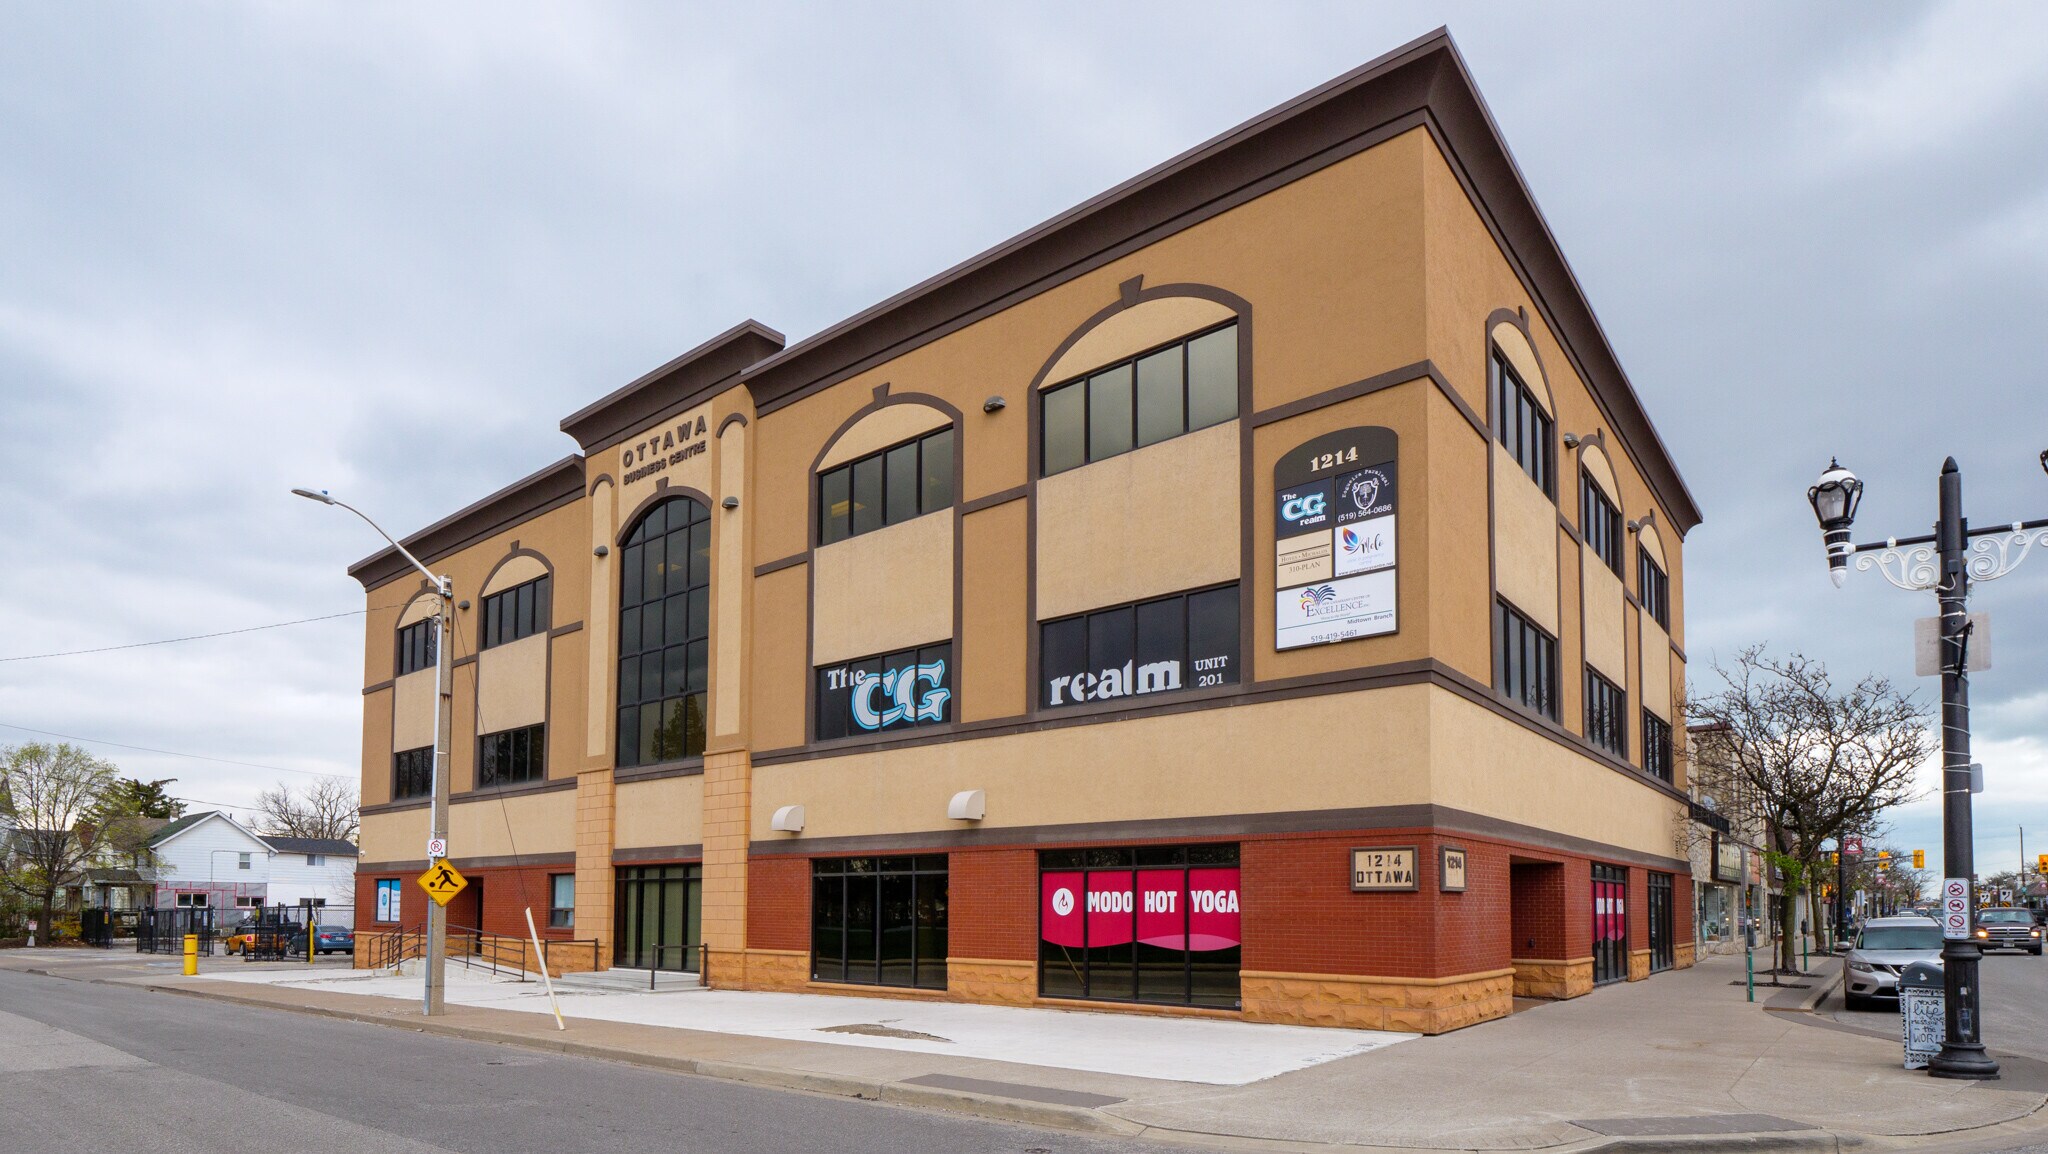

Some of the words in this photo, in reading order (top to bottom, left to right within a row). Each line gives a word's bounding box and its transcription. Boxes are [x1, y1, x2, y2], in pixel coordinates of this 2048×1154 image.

[623, 415, 707, 468] OTTAWA
[623, 457, 667, 486] BUSINESS
[669, 439, 706, 466] CENTRE
[1310, 446, 1358, 472] 1214
[1282, 493, 1297, 502] The
[1281, 492, 1327, 522] CG
[1299, 514, 1327, 526] realm
[1337, 512, 1357, 523] (519)
[1288, 561, 1321, 574] 310-PLAN
[1306, 601, 1364, 617] EXCELLENCE
[1347, 617, 1372, 625] Midtown
[1373, 613, 1393, 621] Branch
[1311, 629, 1357, 642] 519-419-5461
[1049, 659, 1182, 706] realm
[1194, 655, 1228, 672] UNIT
[1198, 673, 1223, 687] 201
[827, 667, 866, 690] The
[851, 659, 951, 730] CG
[1367, 854, 1402, 867] 1214
[1446, 856, 1462, 870] 1214
[1356, 871, 1412, 883] OTTAWA
[1087, 891, 1133, 913] MODO
[1144, 890, 1178, 913] HOT
[1190, 890, 1240, 913] YOGA
[1913, 1002, 1945, 1019] life
